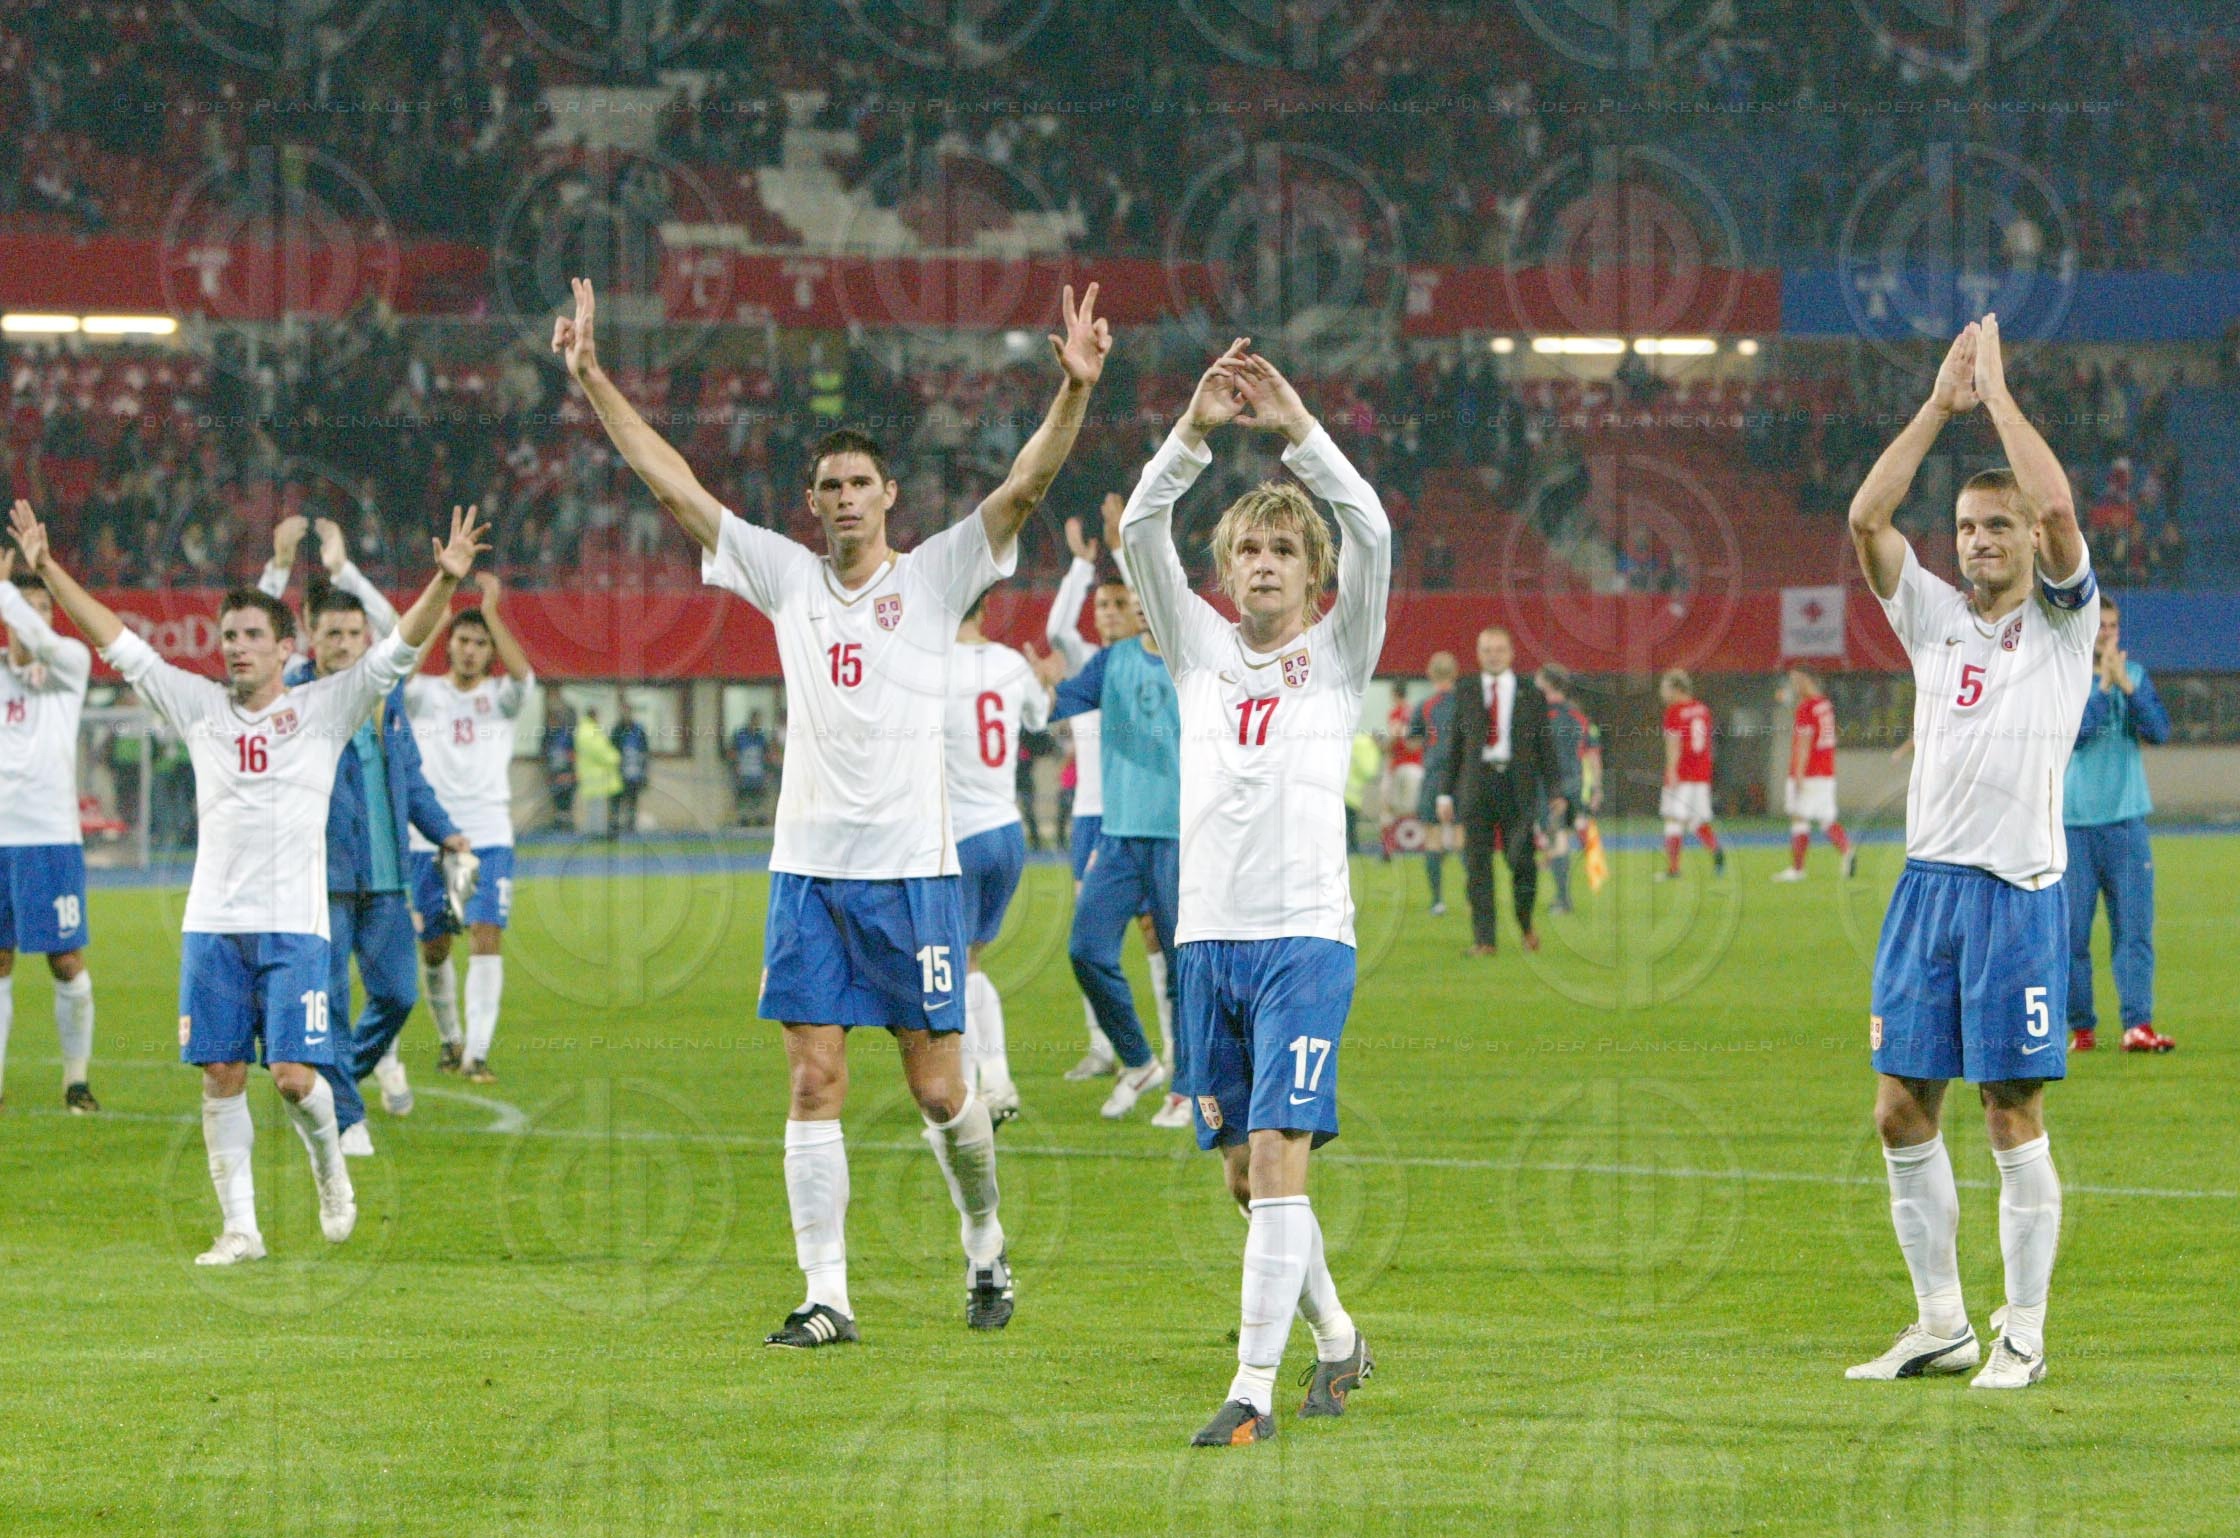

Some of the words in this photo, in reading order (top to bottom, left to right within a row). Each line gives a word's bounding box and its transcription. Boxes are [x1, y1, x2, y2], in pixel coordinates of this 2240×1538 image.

[827, 642, 862, 687] 15
[1957, 665, 1986, 707] 5
[976, 692, 1007, 768] 6
[1236, 697, 1281, 746] 17
[235, 735, 268, 774] 16
[54, 895, 81, 929] 18
[917, 946, 951, 993] 15
[301, 990, 327, 1032] 16
[2025, 977, 2049, 1026] 5
[1290, 1036, 1331, 1091] 17
